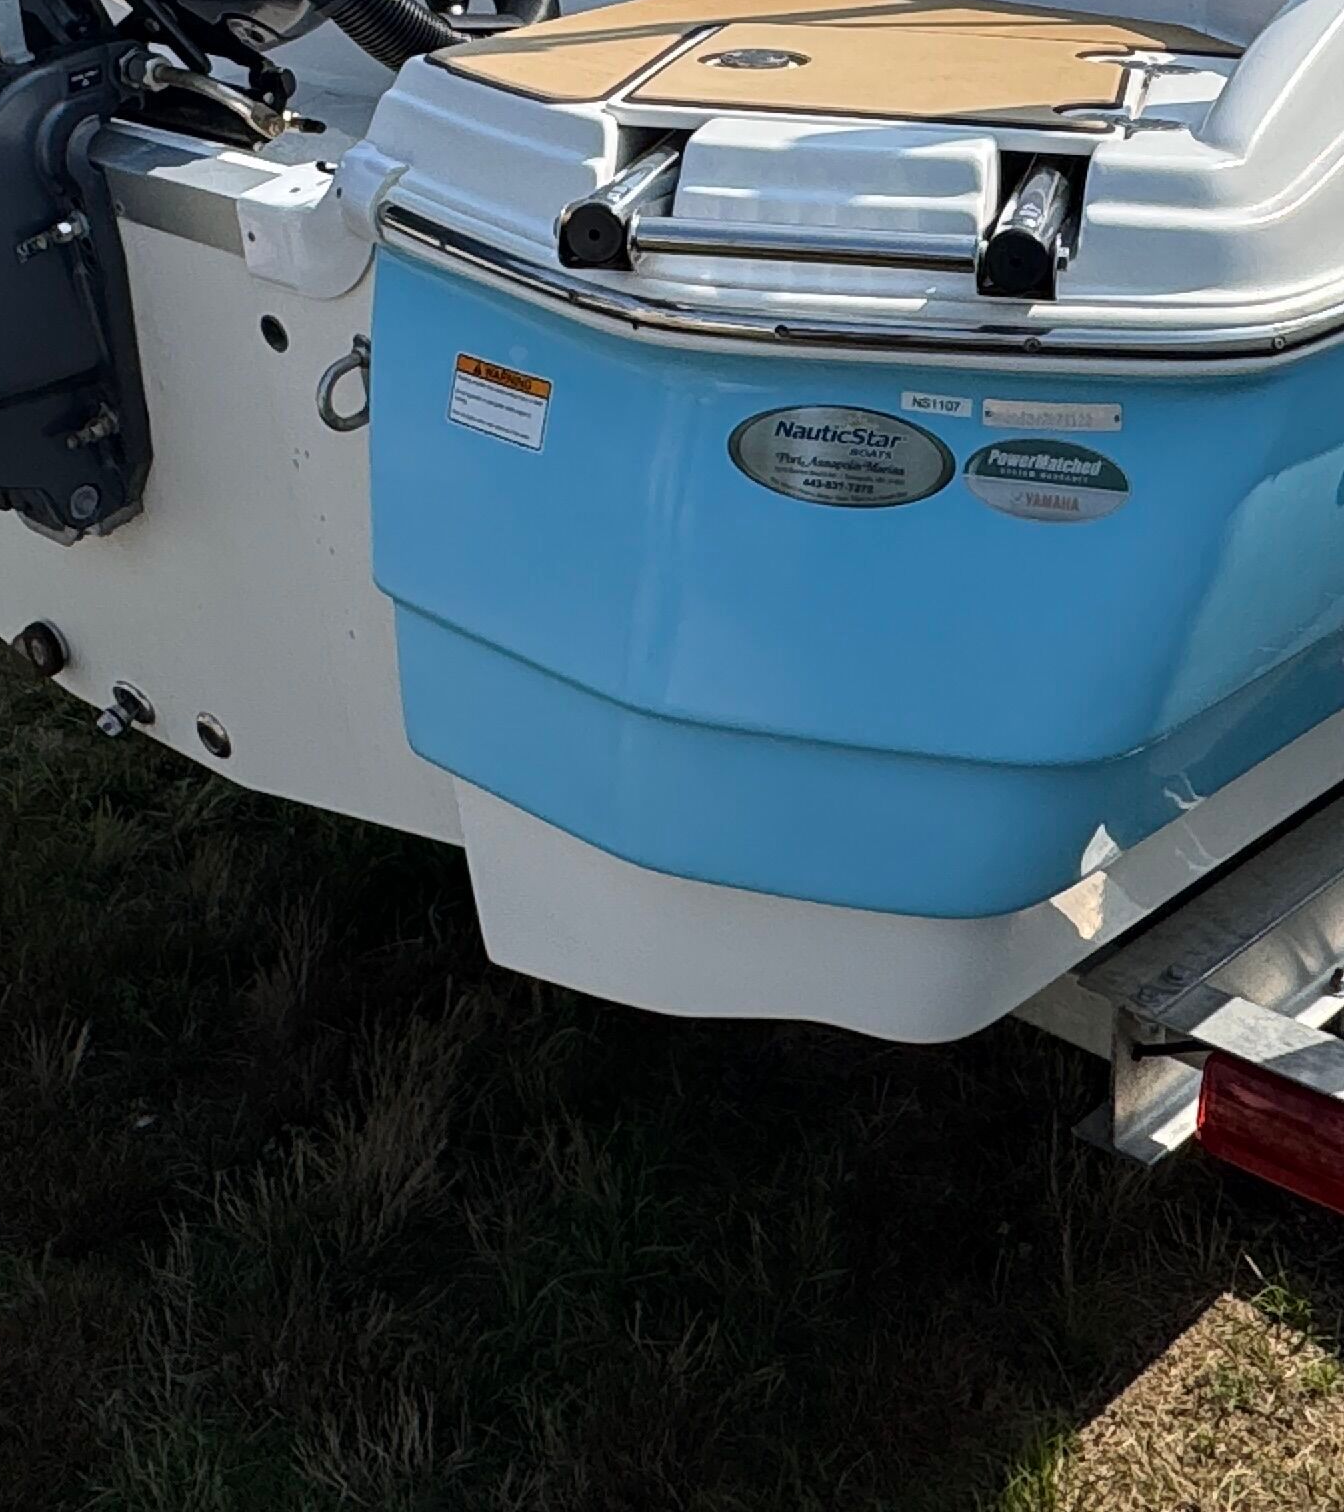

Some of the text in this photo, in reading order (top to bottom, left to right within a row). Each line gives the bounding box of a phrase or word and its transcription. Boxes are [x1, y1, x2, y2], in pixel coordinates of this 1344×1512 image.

[912, 395, 961, 412] NS1107
[775, 420, 902, 448] NauticStar
[988, 449, 1102, 476] PowerMatched
[1025, 492, 1080, 512] YAMAHA
